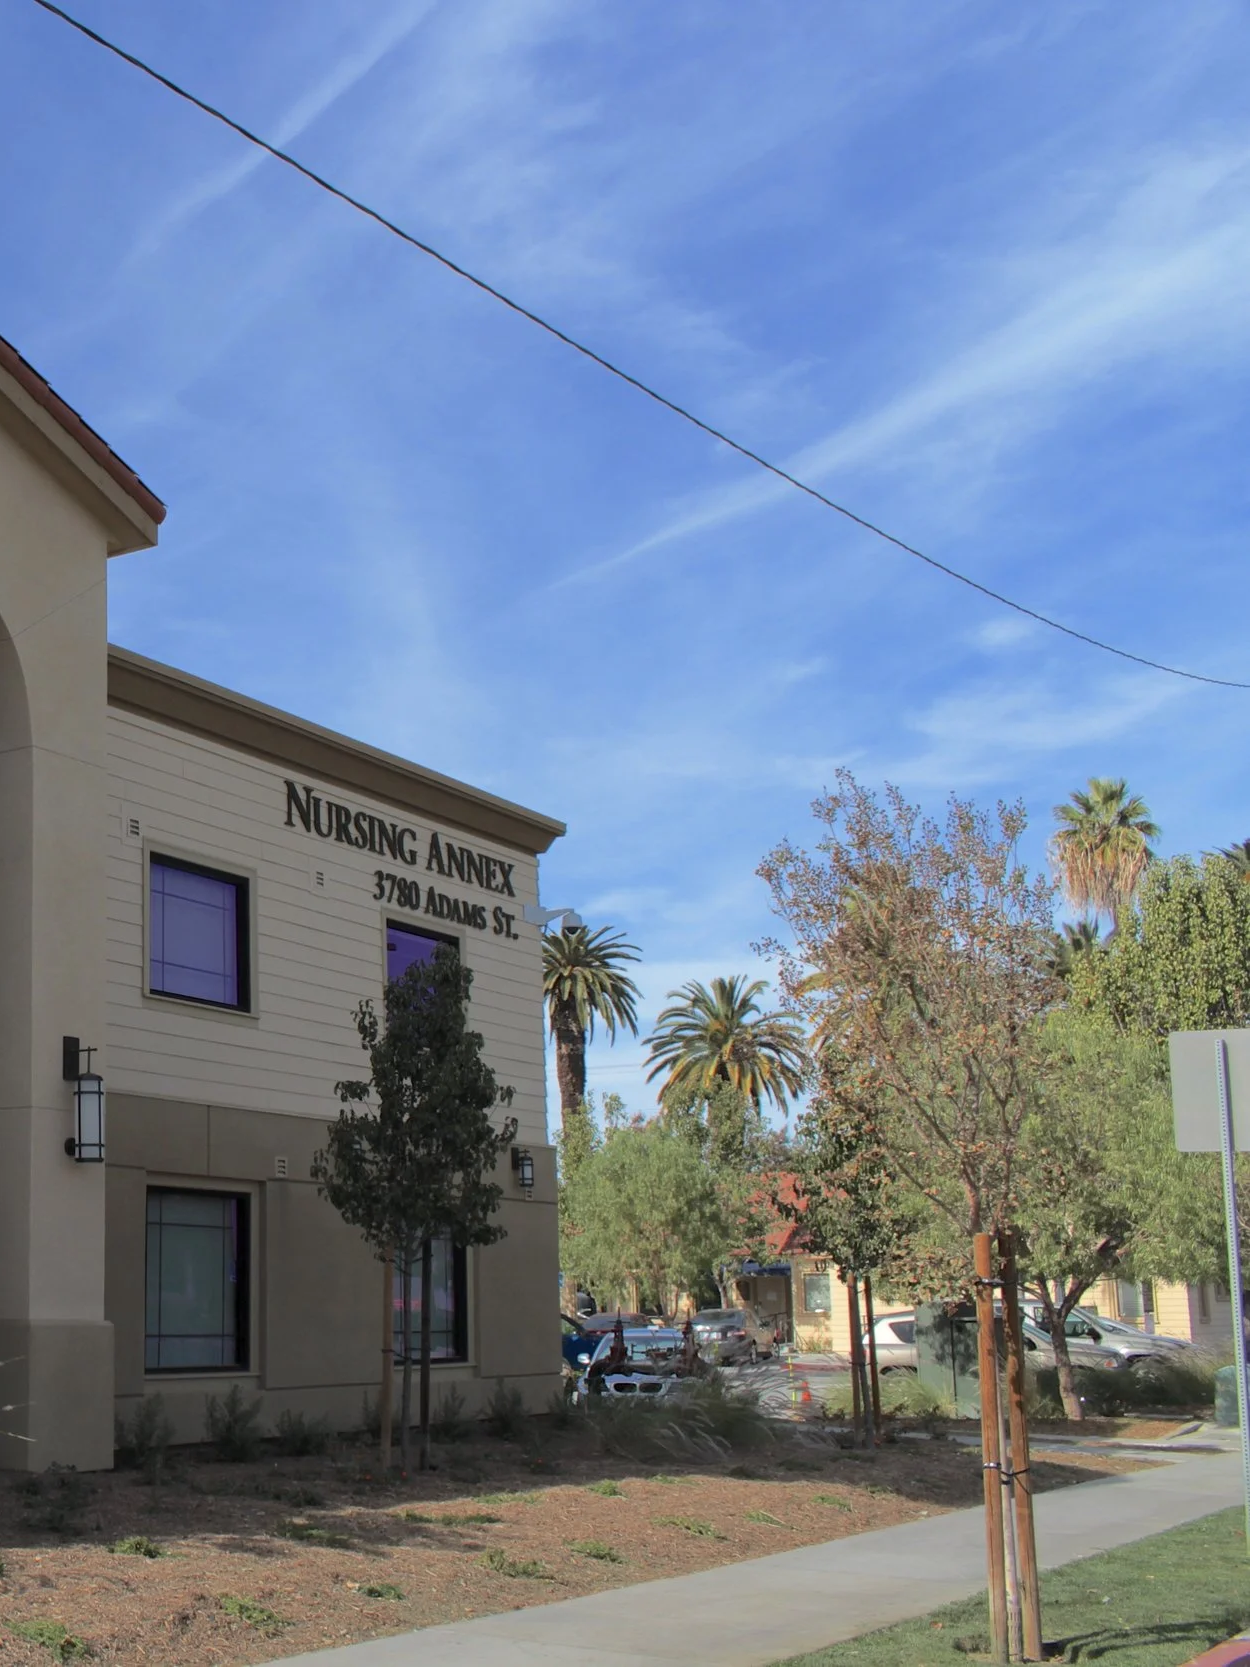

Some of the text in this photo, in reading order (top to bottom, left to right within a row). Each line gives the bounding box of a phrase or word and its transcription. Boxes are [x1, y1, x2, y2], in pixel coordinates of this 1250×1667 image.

[284, 780, 516, 897] NURSING ANNEX
[373, 870, 518, 940] 3780 ADAMS ST.
